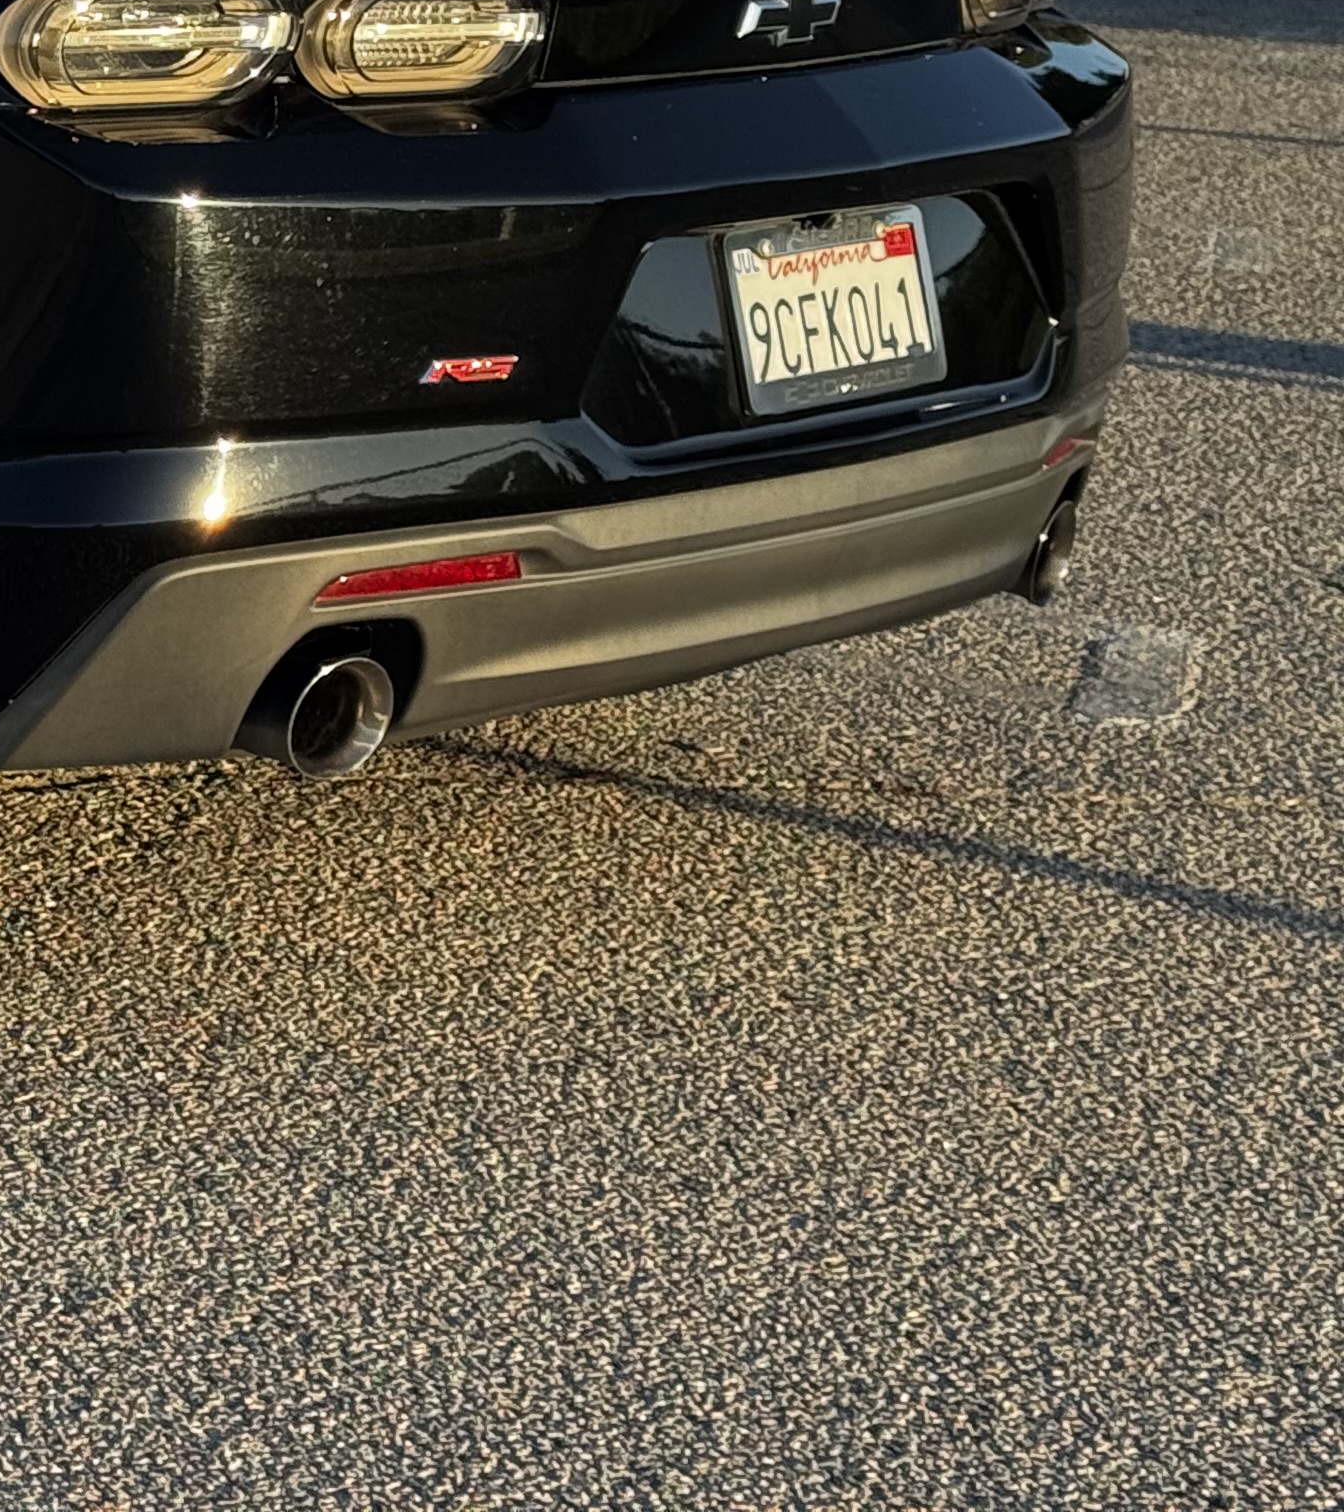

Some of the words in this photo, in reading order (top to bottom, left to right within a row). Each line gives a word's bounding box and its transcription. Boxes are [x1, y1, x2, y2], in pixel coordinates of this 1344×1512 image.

[733, 253, 760, 274] JUL
[767, 243, 887, 285] California
[749, 277, 919, 384] 9CFK041
[419, 355, 519, 383] RS
